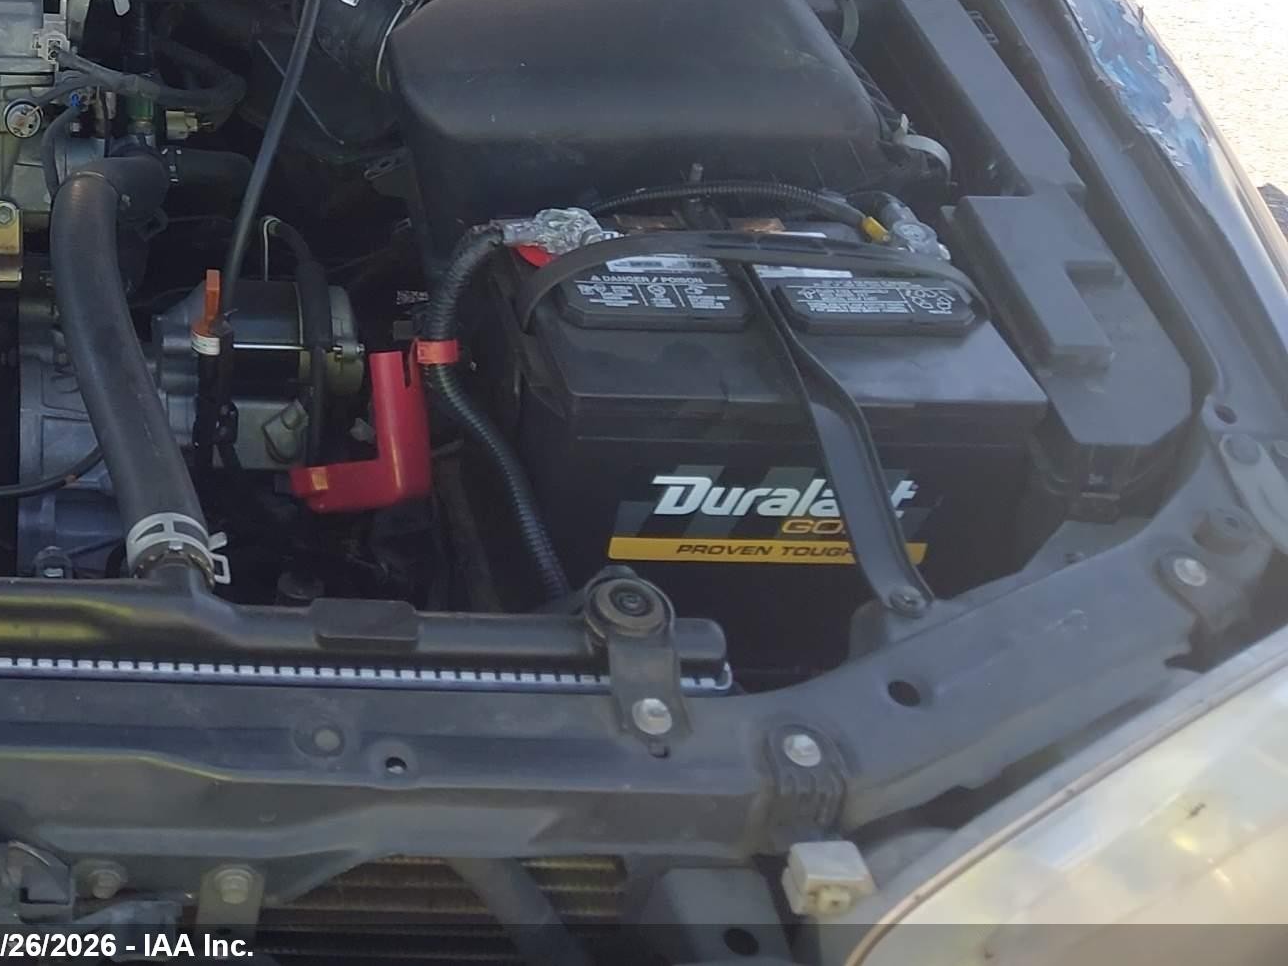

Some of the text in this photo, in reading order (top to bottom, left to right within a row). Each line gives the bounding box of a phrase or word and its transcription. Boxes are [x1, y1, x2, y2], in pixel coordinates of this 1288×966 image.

[603, 275, 649, 283] DANGER
[652, 475, 916, 519] Duralat
[676, 544, 772, 556] PROVEN
